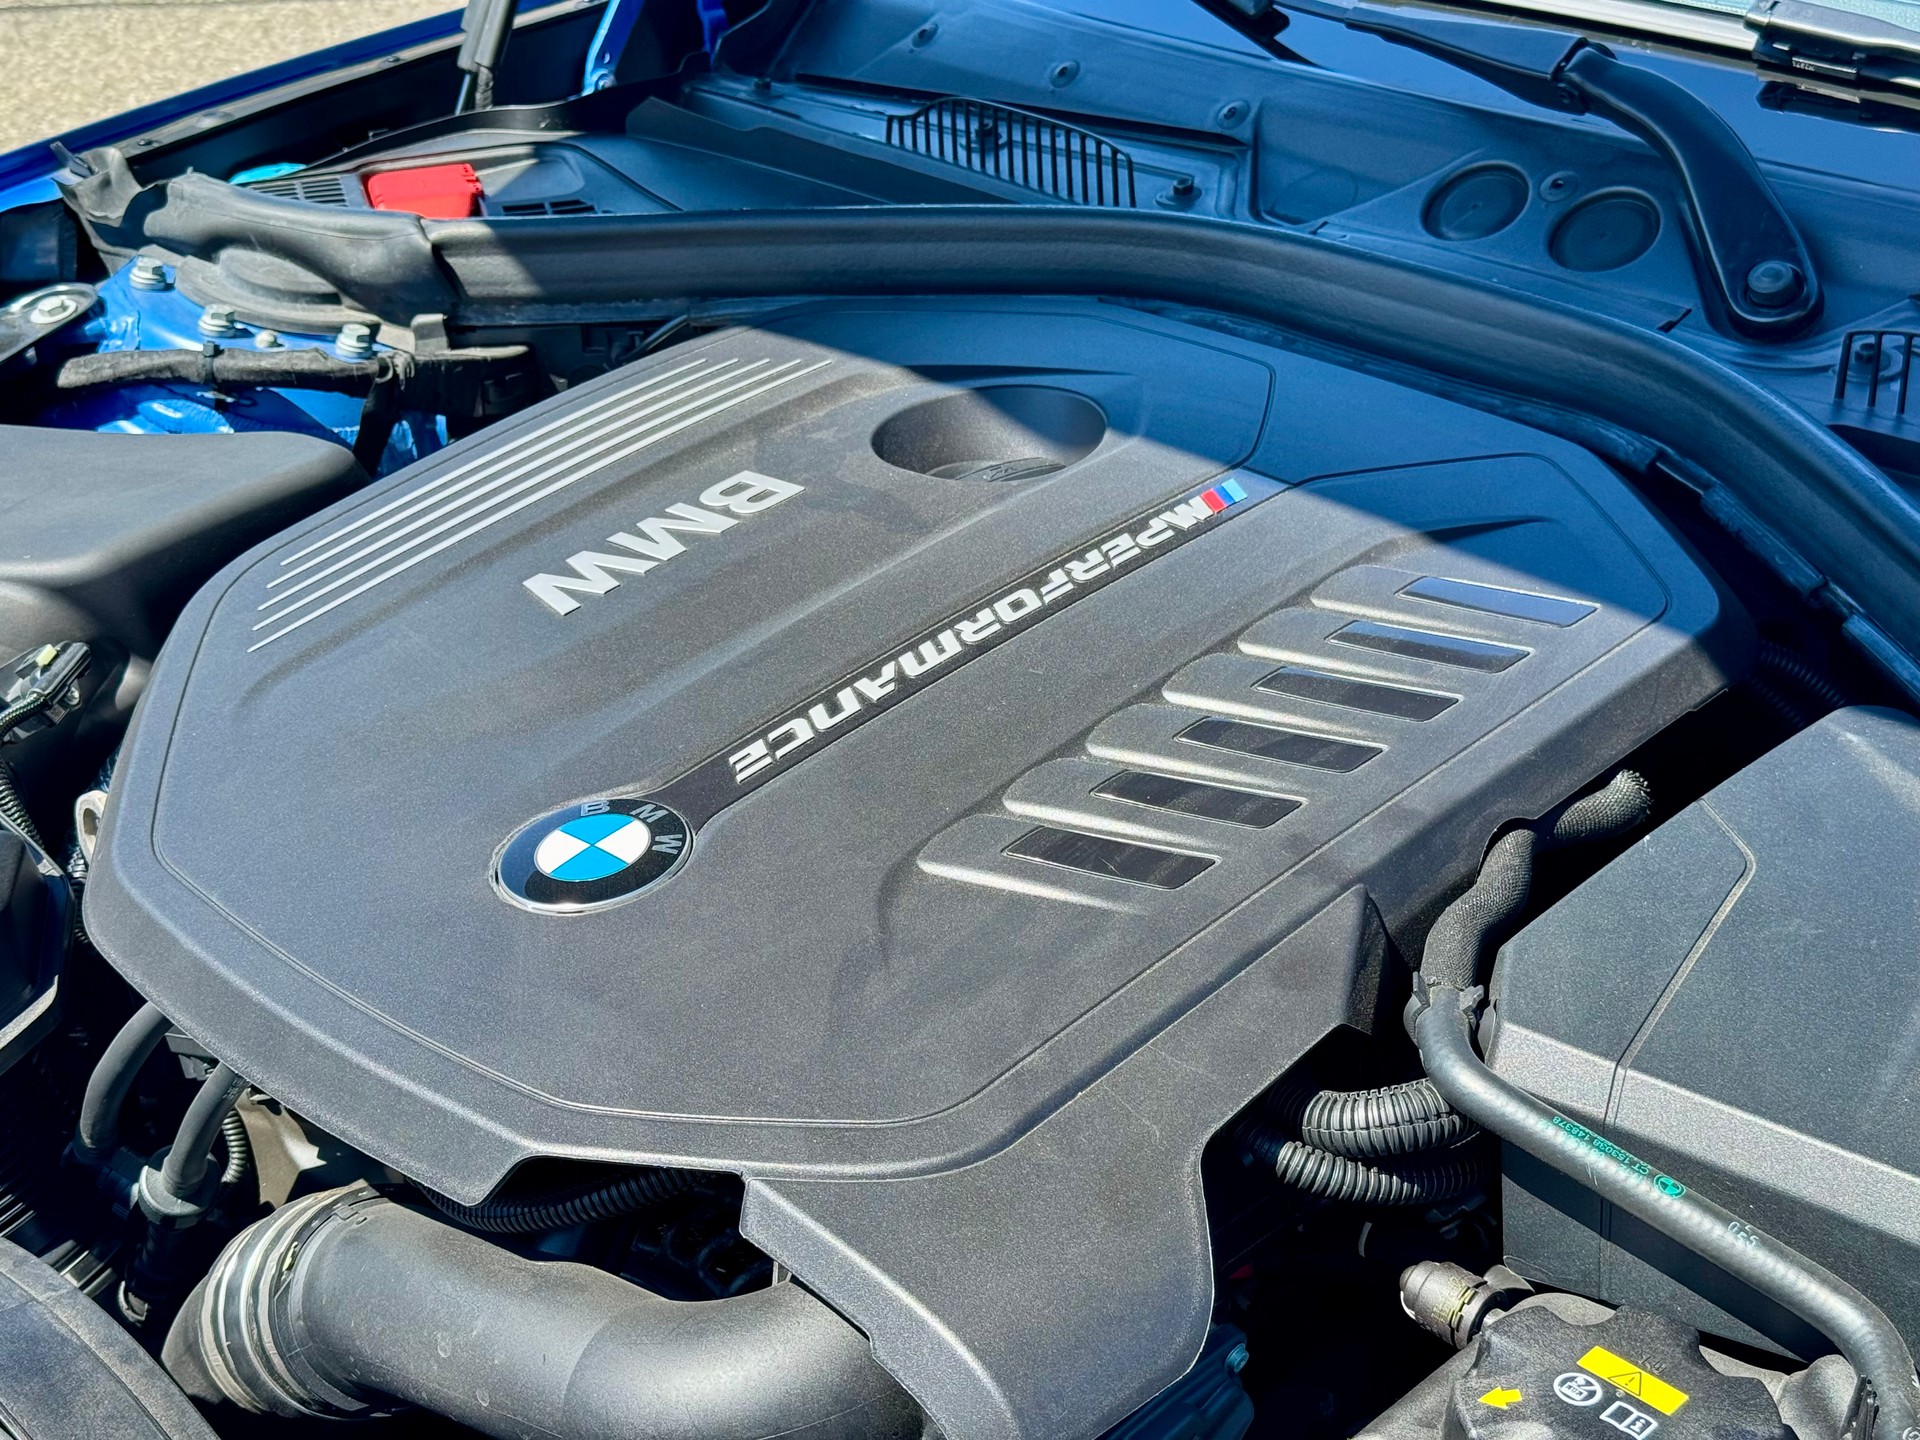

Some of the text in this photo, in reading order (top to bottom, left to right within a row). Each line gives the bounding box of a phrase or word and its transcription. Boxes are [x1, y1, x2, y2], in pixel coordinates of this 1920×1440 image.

[522, 470, 806, 617] BMW
[580, 799, 685, 855] BMW
[1552, 1115, 1590, 1141] 148378
[1592, 1137, 1630, 1164] 153038
